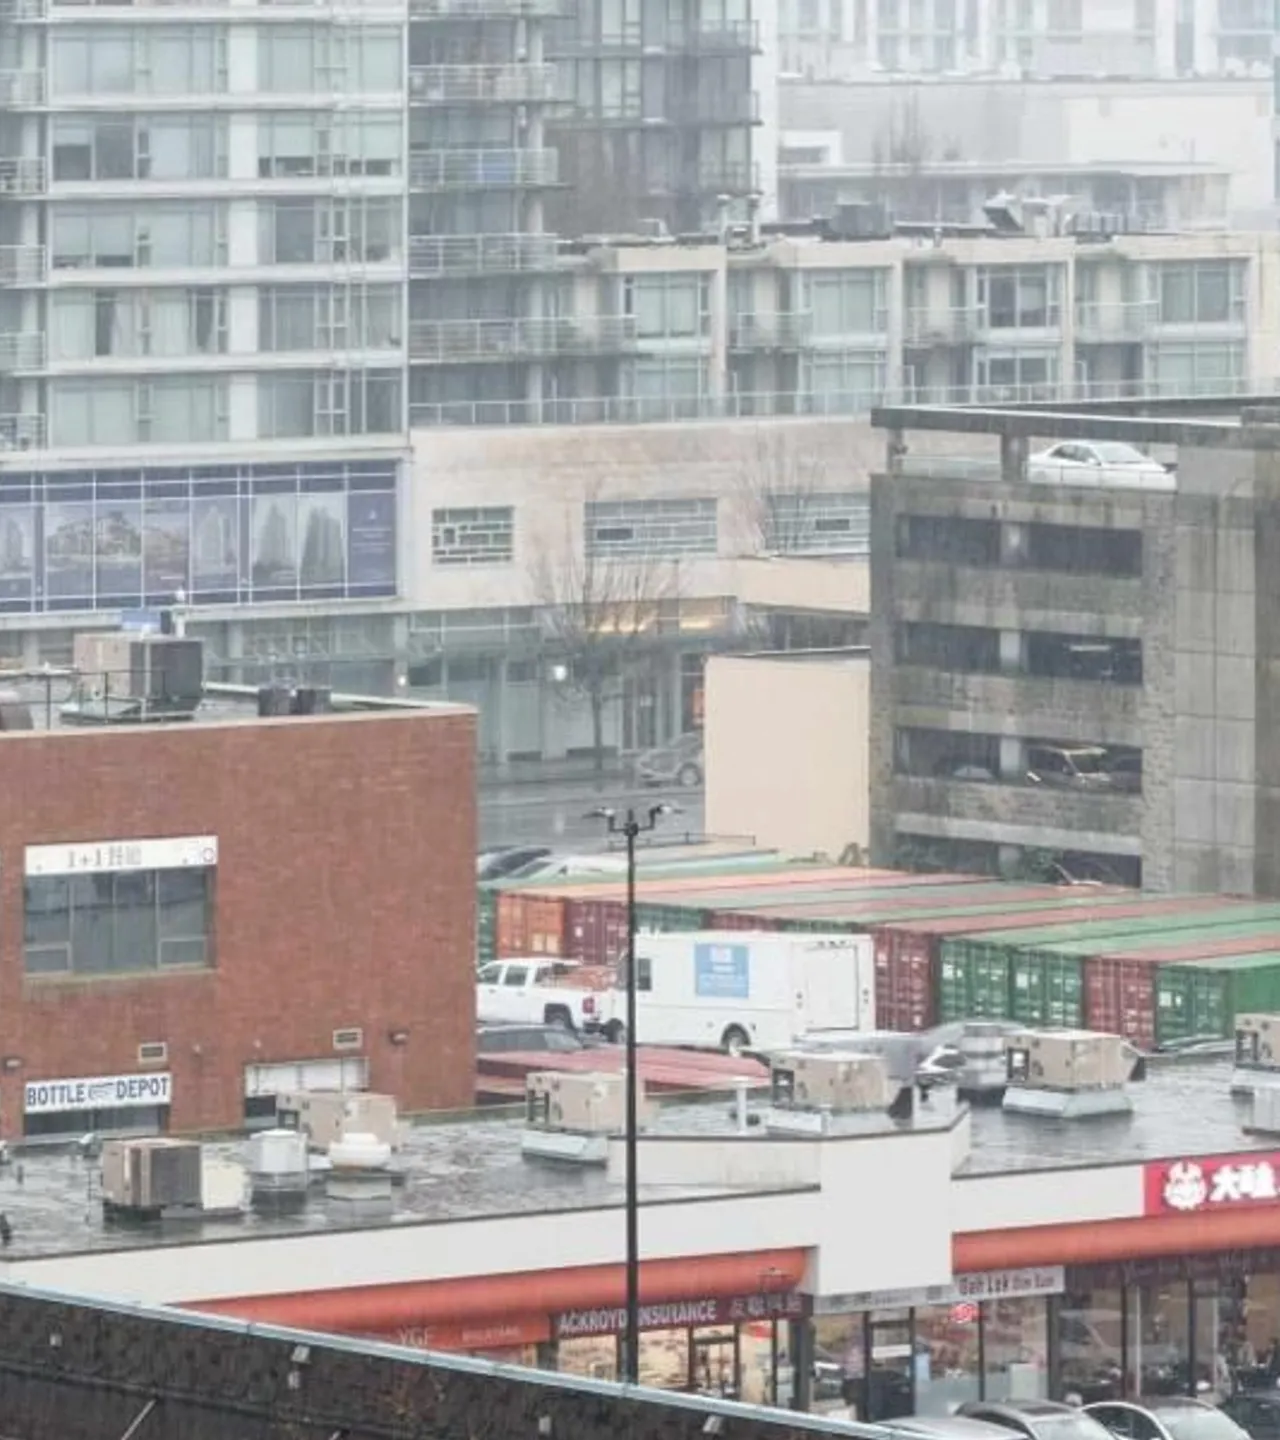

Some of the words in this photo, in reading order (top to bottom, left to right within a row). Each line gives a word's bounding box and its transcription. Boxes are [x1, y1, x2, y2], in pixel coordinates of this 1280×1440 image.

[26, 1083, 86, 1107] BOTTLE
[116, 1077, 169, 1099] DEPOT
[637, 1299, 718, 1327] NSURANCE
